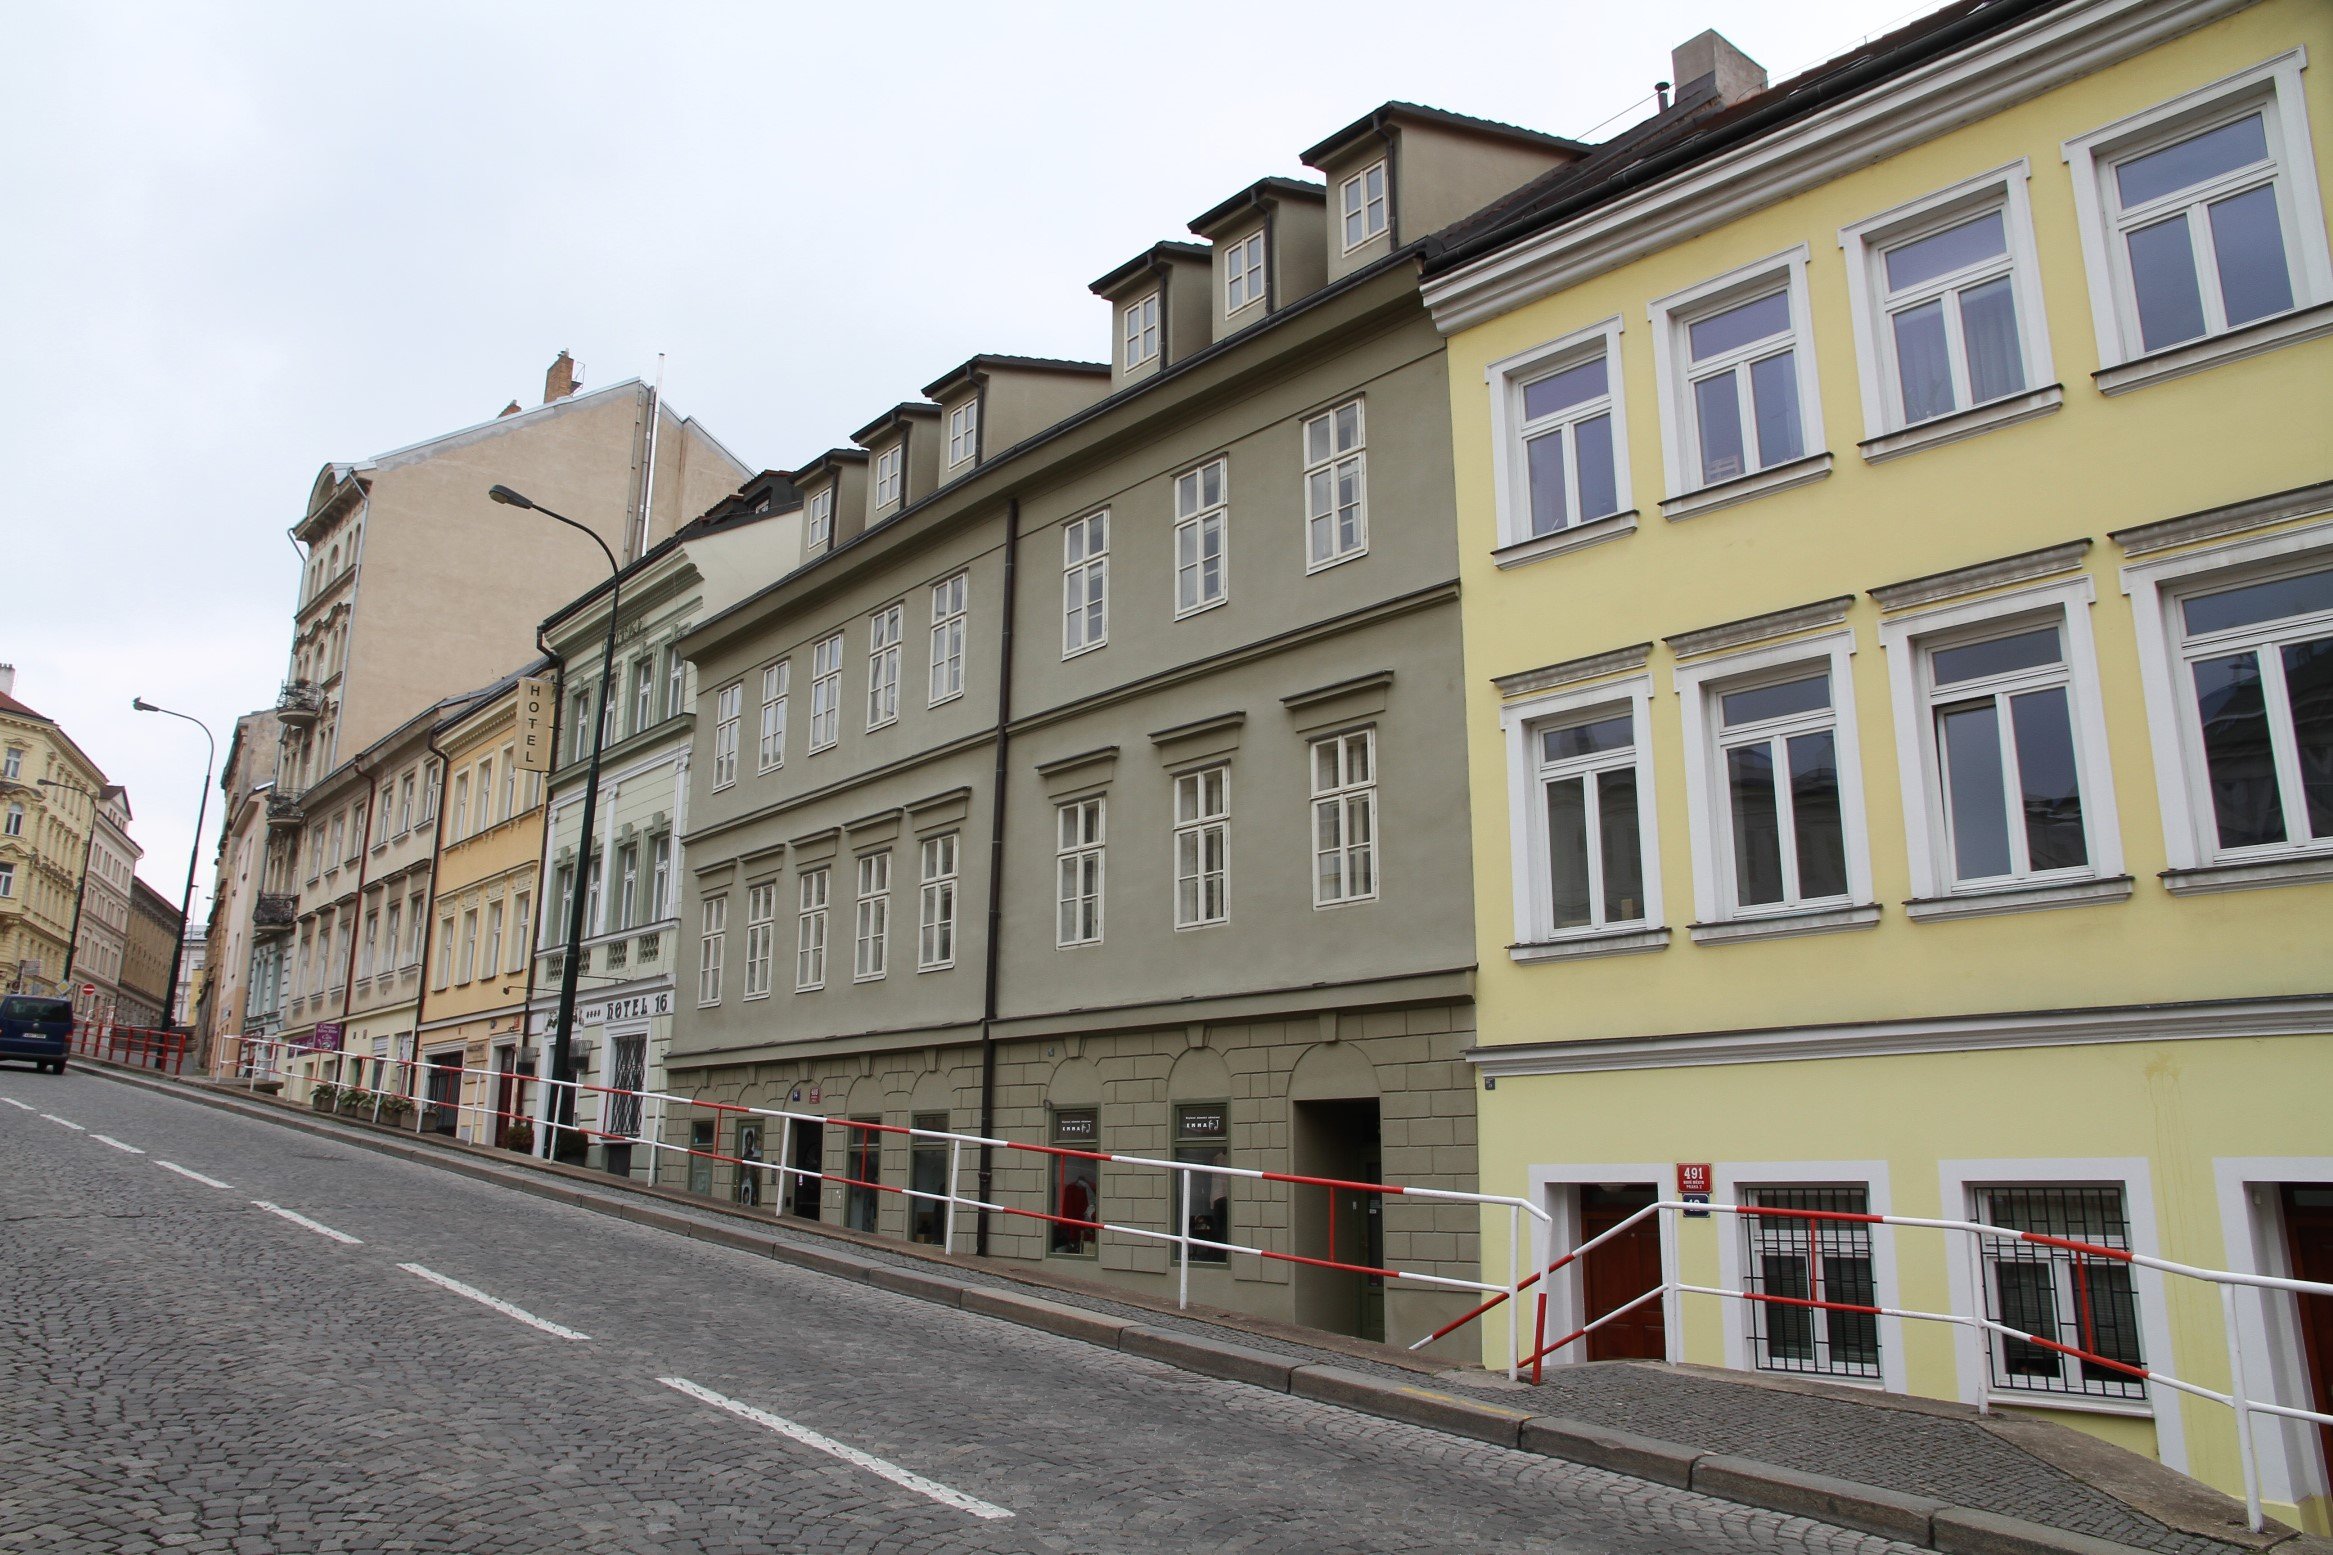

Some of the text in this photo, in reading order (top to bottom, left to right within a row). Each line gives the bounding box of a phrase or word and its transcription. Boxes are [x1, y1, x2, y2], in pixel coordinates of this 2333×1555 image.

[526, 685, 540, 762] HOTEL
[606, 994, 667, 1020] HOTEL 16
[1684, 1167, 1703, 1180] 491
